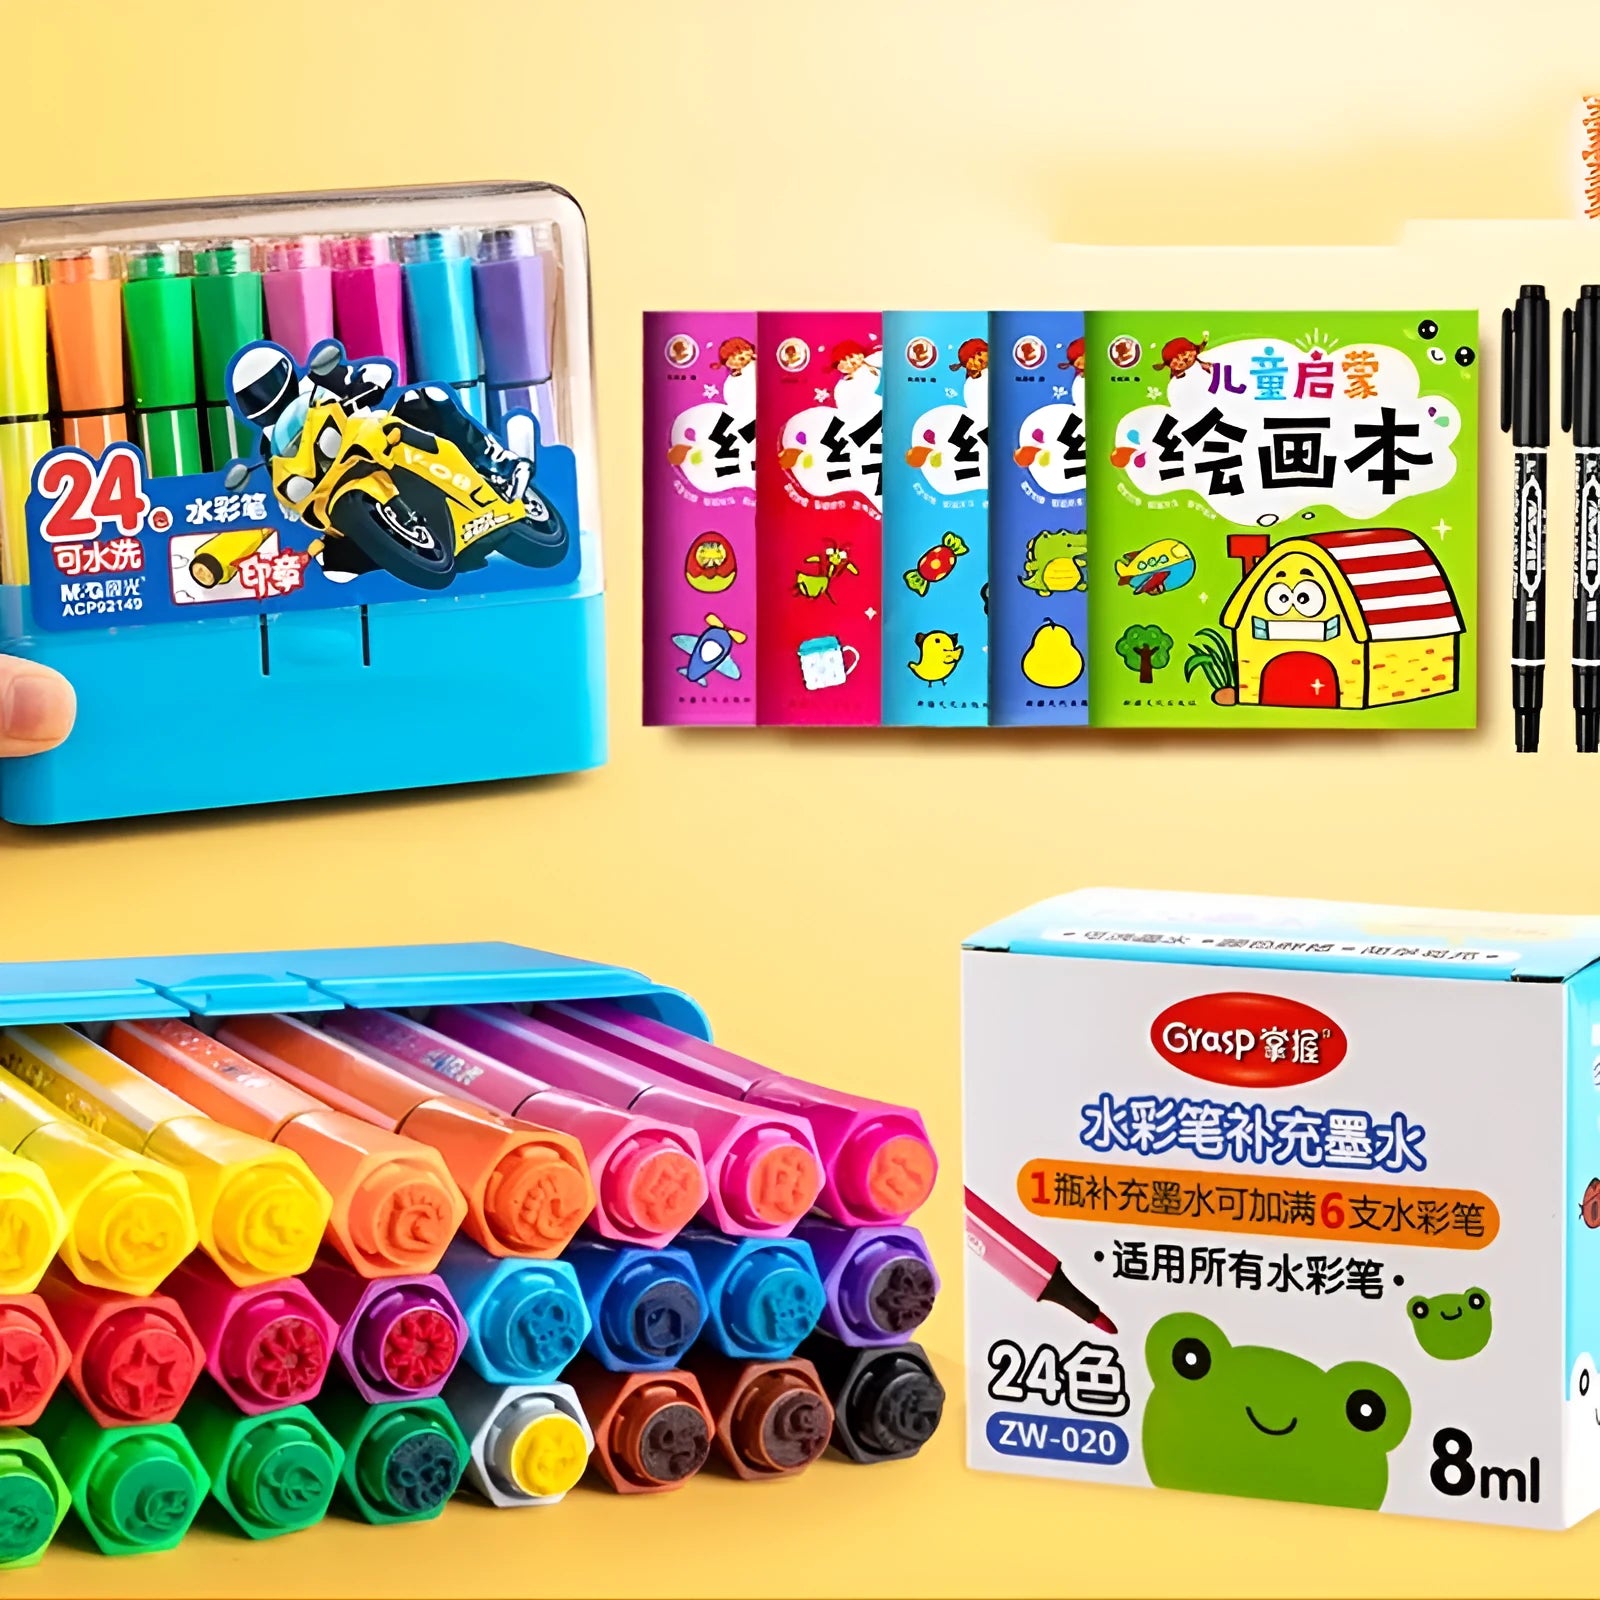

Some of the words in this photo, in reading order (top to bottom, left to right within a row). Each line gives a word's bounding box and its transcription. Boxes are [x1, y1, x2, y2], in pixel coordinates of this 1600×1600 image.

[1208, 346, 1379, 400] 儿童启蒙
[1152, 406, 1433, 496] 绘画本
[185, 493, 268, 525] 水彩笔
[53, 538, 142, 575] 可水洗
[238, 553, 302, 598] 印章
[1162, 1021, 1256, 1061] Grasp
[1259, 1026, 1320, 1064] 掌握
[1081, 1094, 1426, 1173] 水彩笔补充墨水
[1029, 1171, 1486, 1238] 1瓶补充墨水可加满6支水彩笔
[1112, 1240, 1385, 1299] 适用所有水彩笔
[988, 1339, 1130, 1417] 24色
[998, 1419, 1117, 1456] ZW-020
[1430, 1427, 1540, 1503] 8ml
